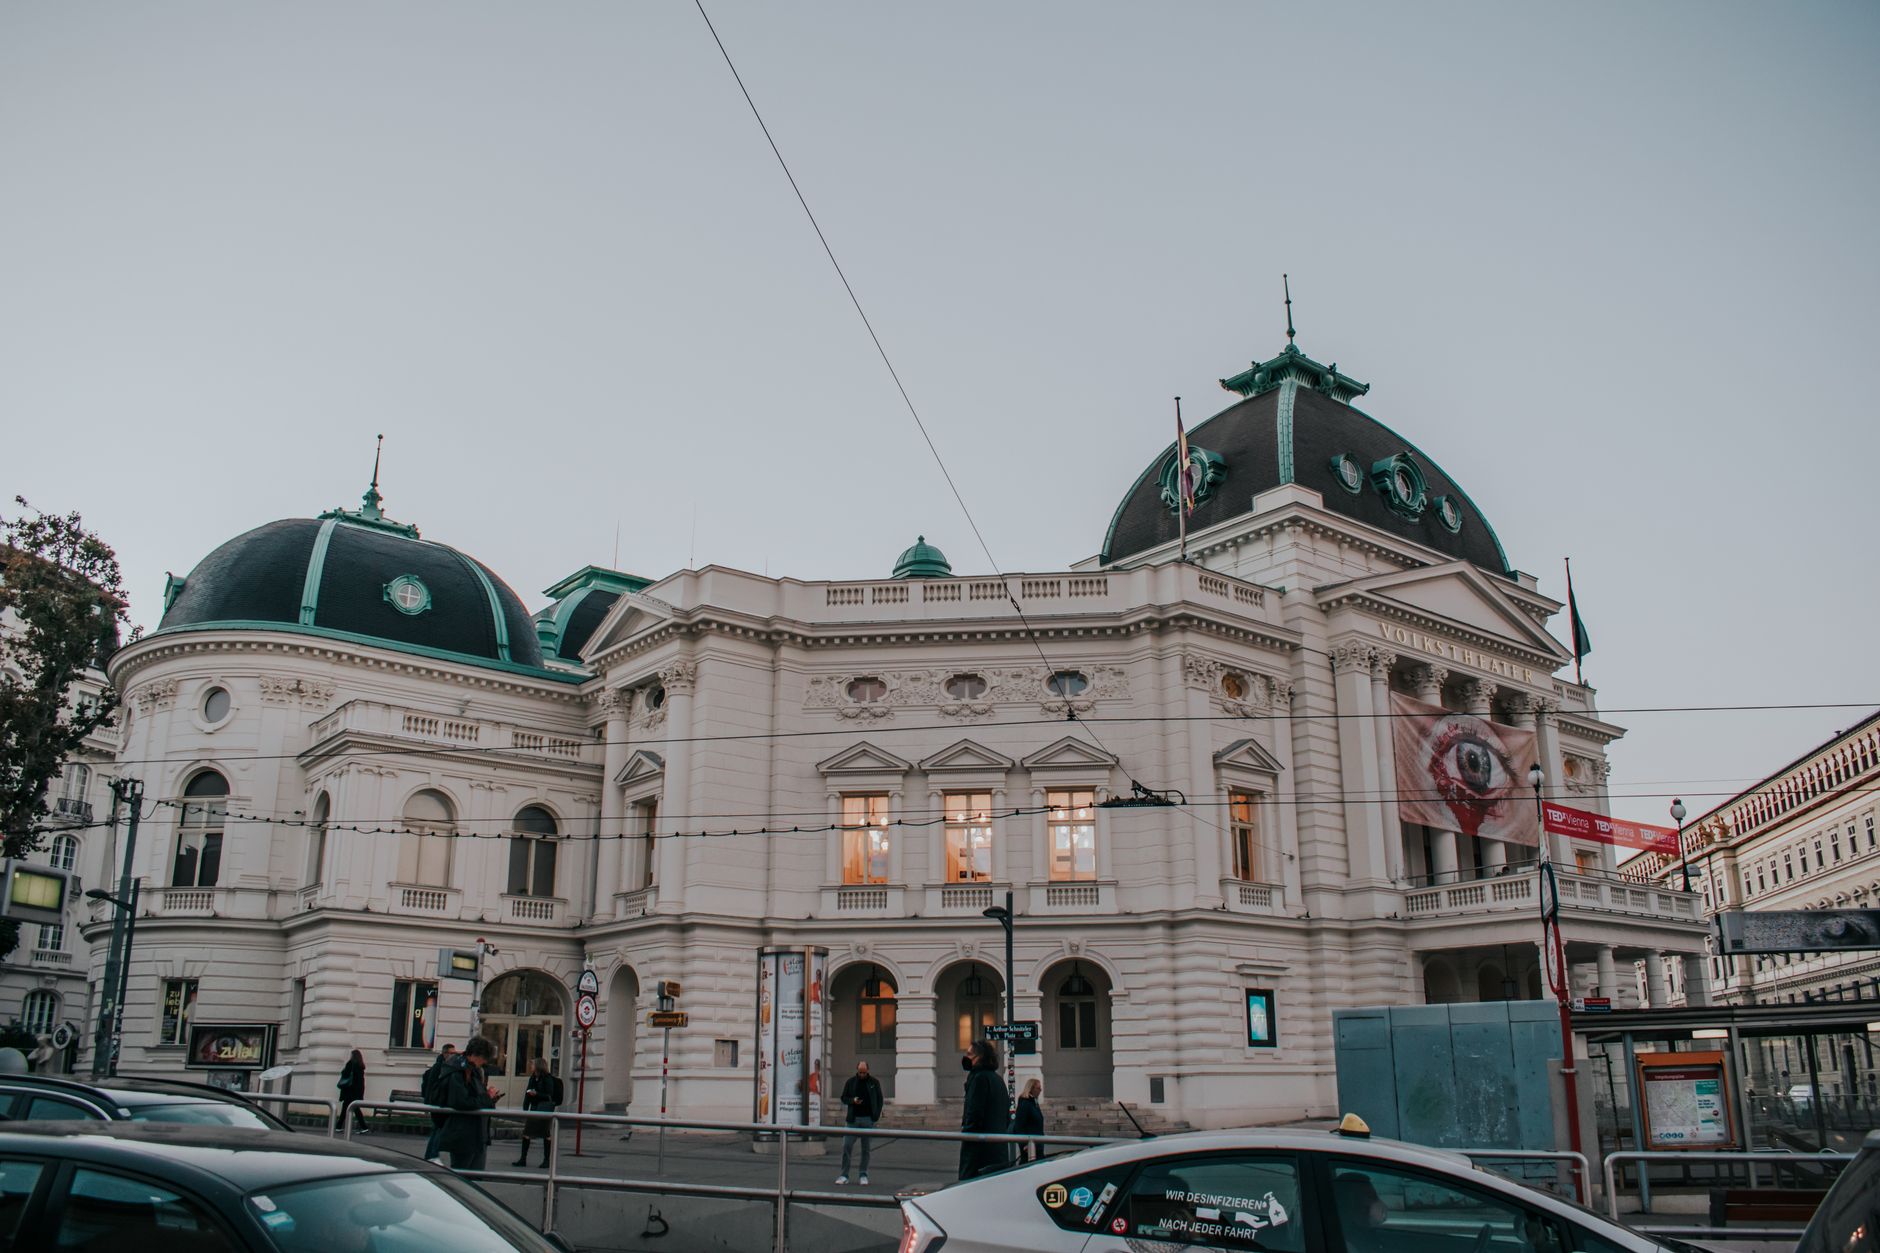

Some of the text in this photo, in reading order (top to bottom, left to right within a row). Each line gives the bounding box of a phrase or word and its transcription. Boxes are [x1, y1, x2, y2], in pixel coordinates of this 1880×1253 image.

[1380, 622, 1534, 683] VOLKSTHEATER
[1165, 1189, 1262, 1210] WIR DESINFIZIEREN
[1158, 1218, 1258, 1240] NACH JEDER FAHRT
